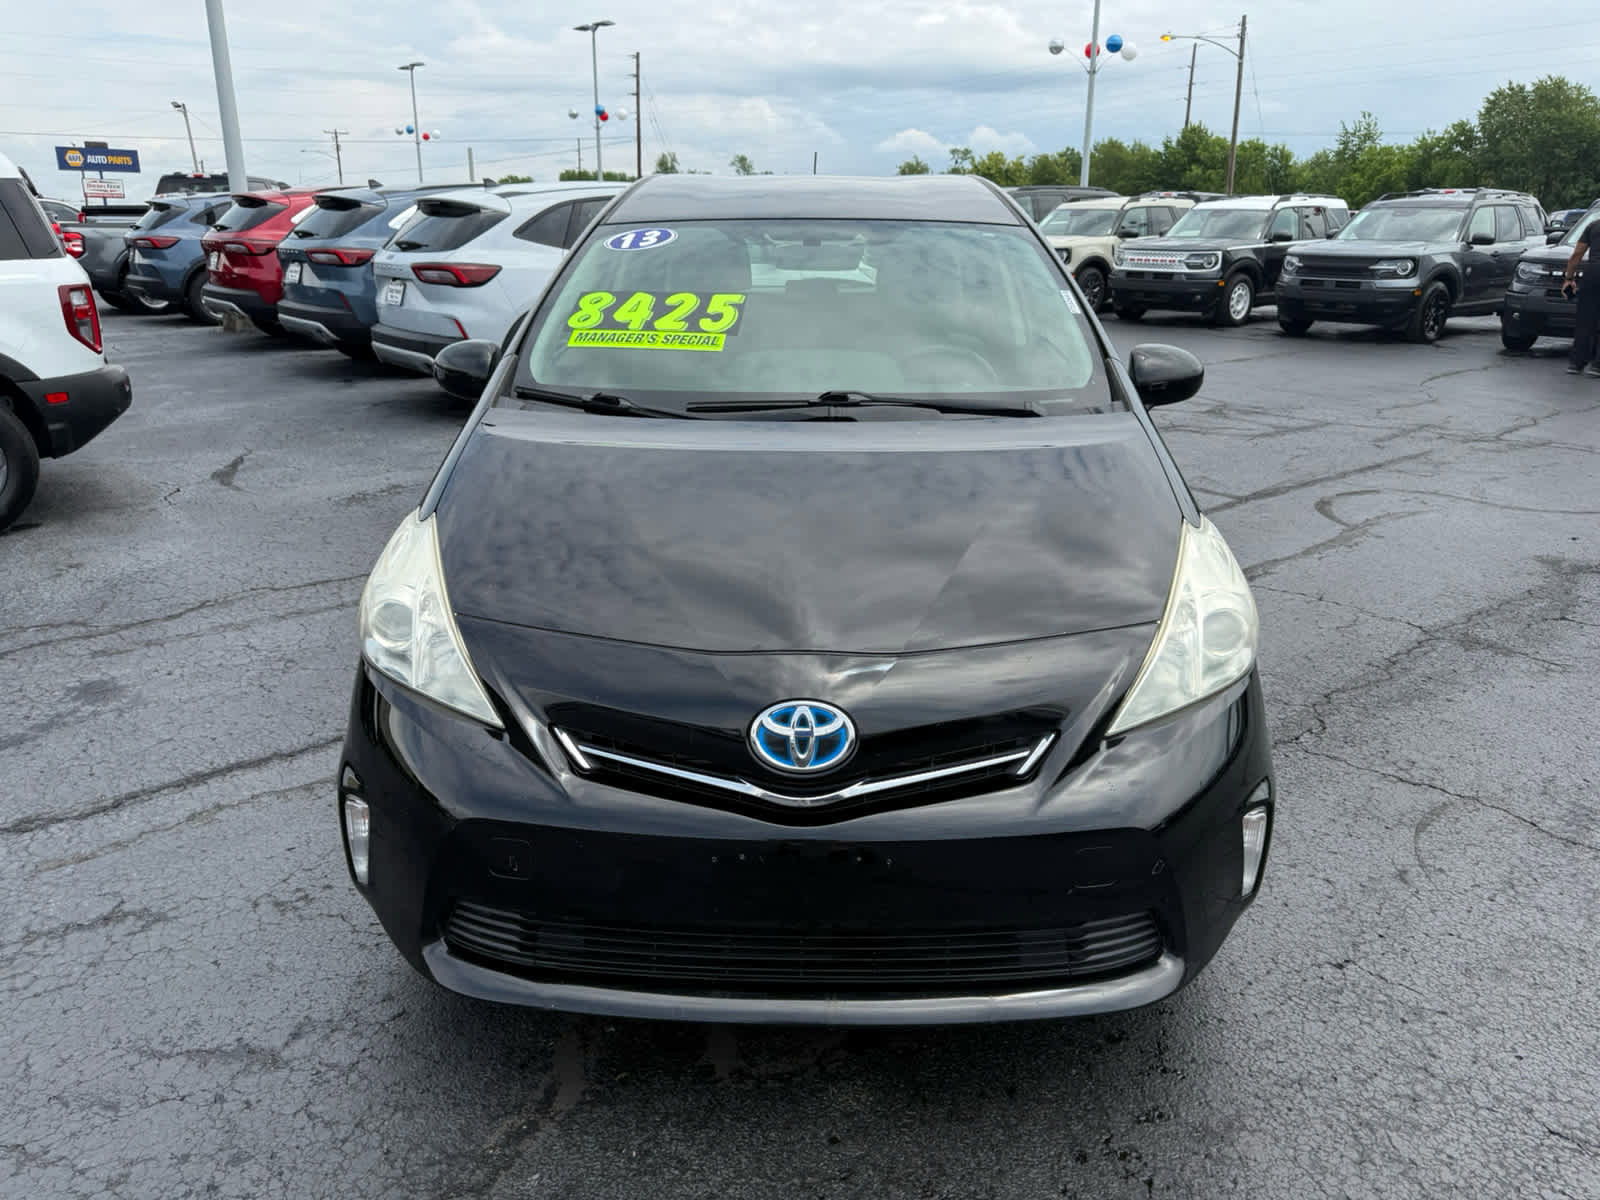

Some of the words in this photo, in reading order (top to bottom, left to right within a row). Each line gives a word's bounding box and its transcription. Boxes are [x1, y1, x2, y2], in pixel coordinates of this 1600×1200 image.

[87, 155, 107, 164] AUTO
[107, 156, 132, 165] PARTS
[620, 230, 662, 249] 13
[567, 291, 746, 333] 8425
[574, 332, 657, 345] MANAGER'S
[661, 334, 721, 346] SPECIAL
